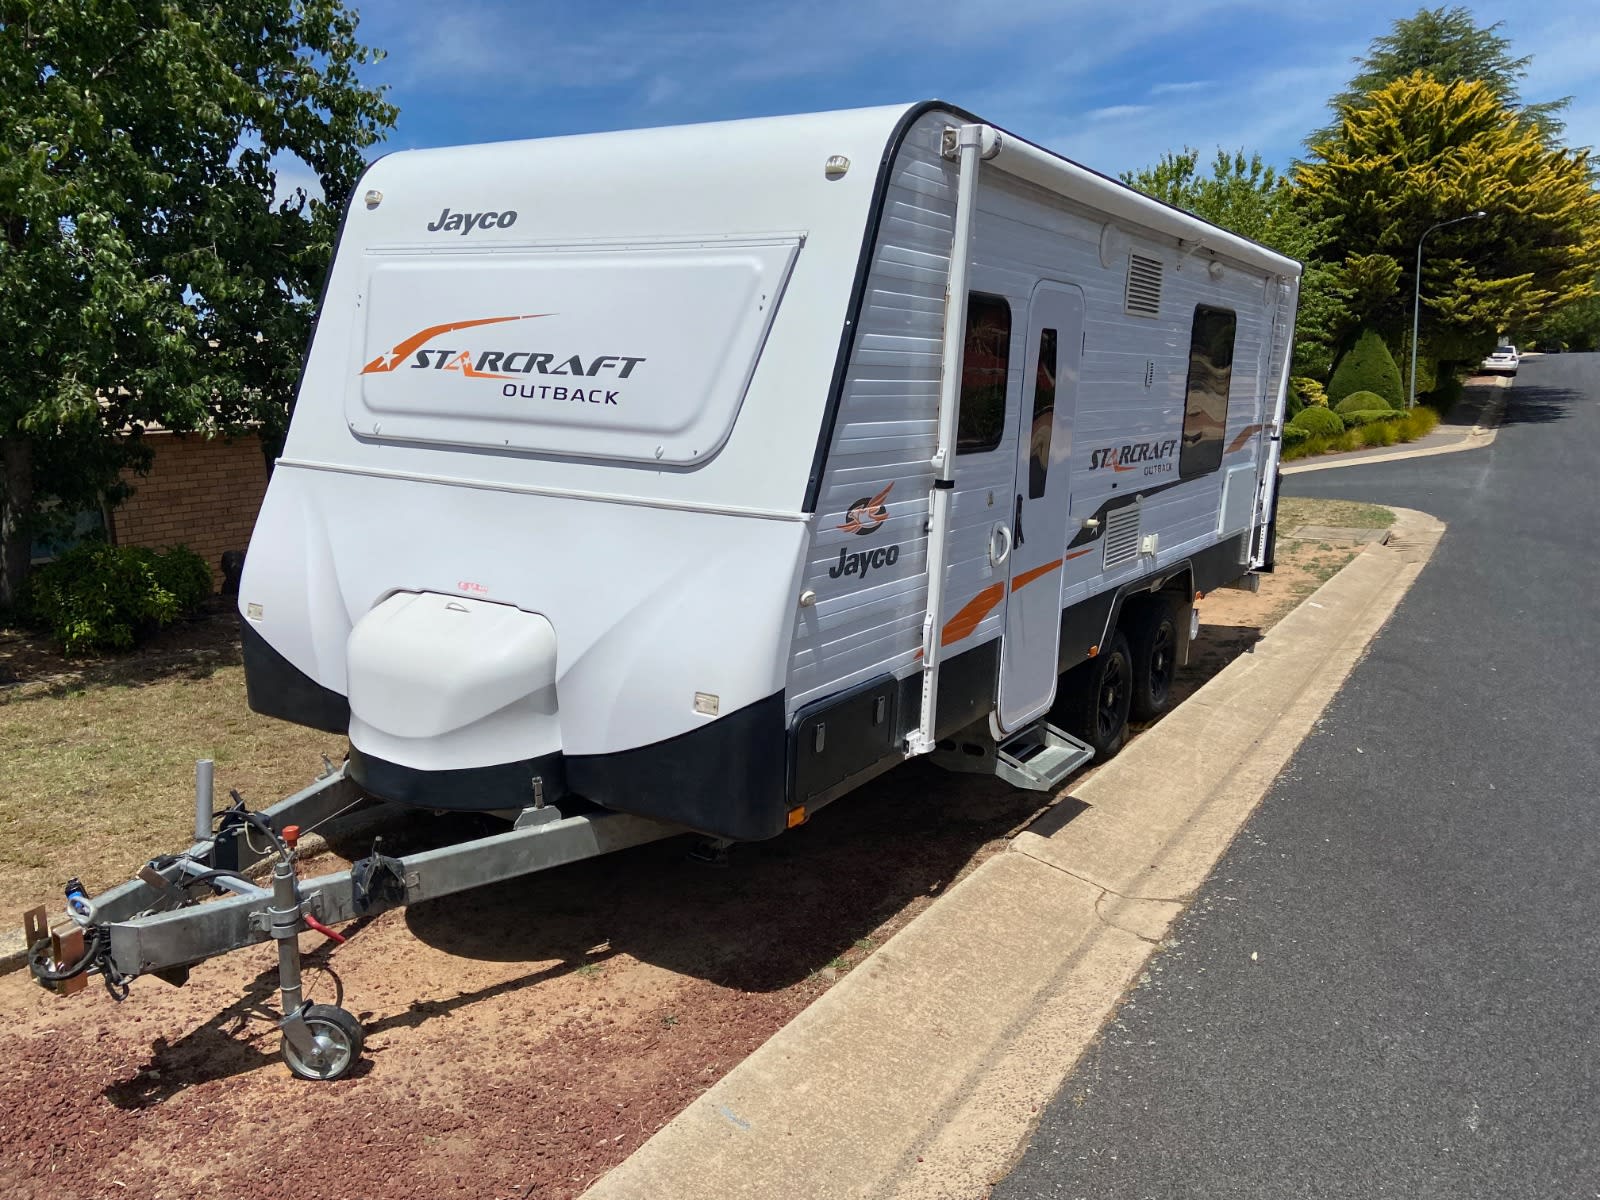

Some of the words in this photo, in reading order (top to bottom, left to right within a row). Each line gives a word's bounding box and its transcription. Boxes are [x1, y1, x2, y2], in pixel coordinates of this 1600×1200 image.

[427, 207, 518, 235] Jayco
[410, 349, 647, 379] STARCRAFT
[502, 383, 620, 405] OUTBACK
[1089, 439, 1178, 472] STARCRAFT
[1143, 462, 1173, 476] OUTBACK
[828, 545, 900, 579] Jayco
